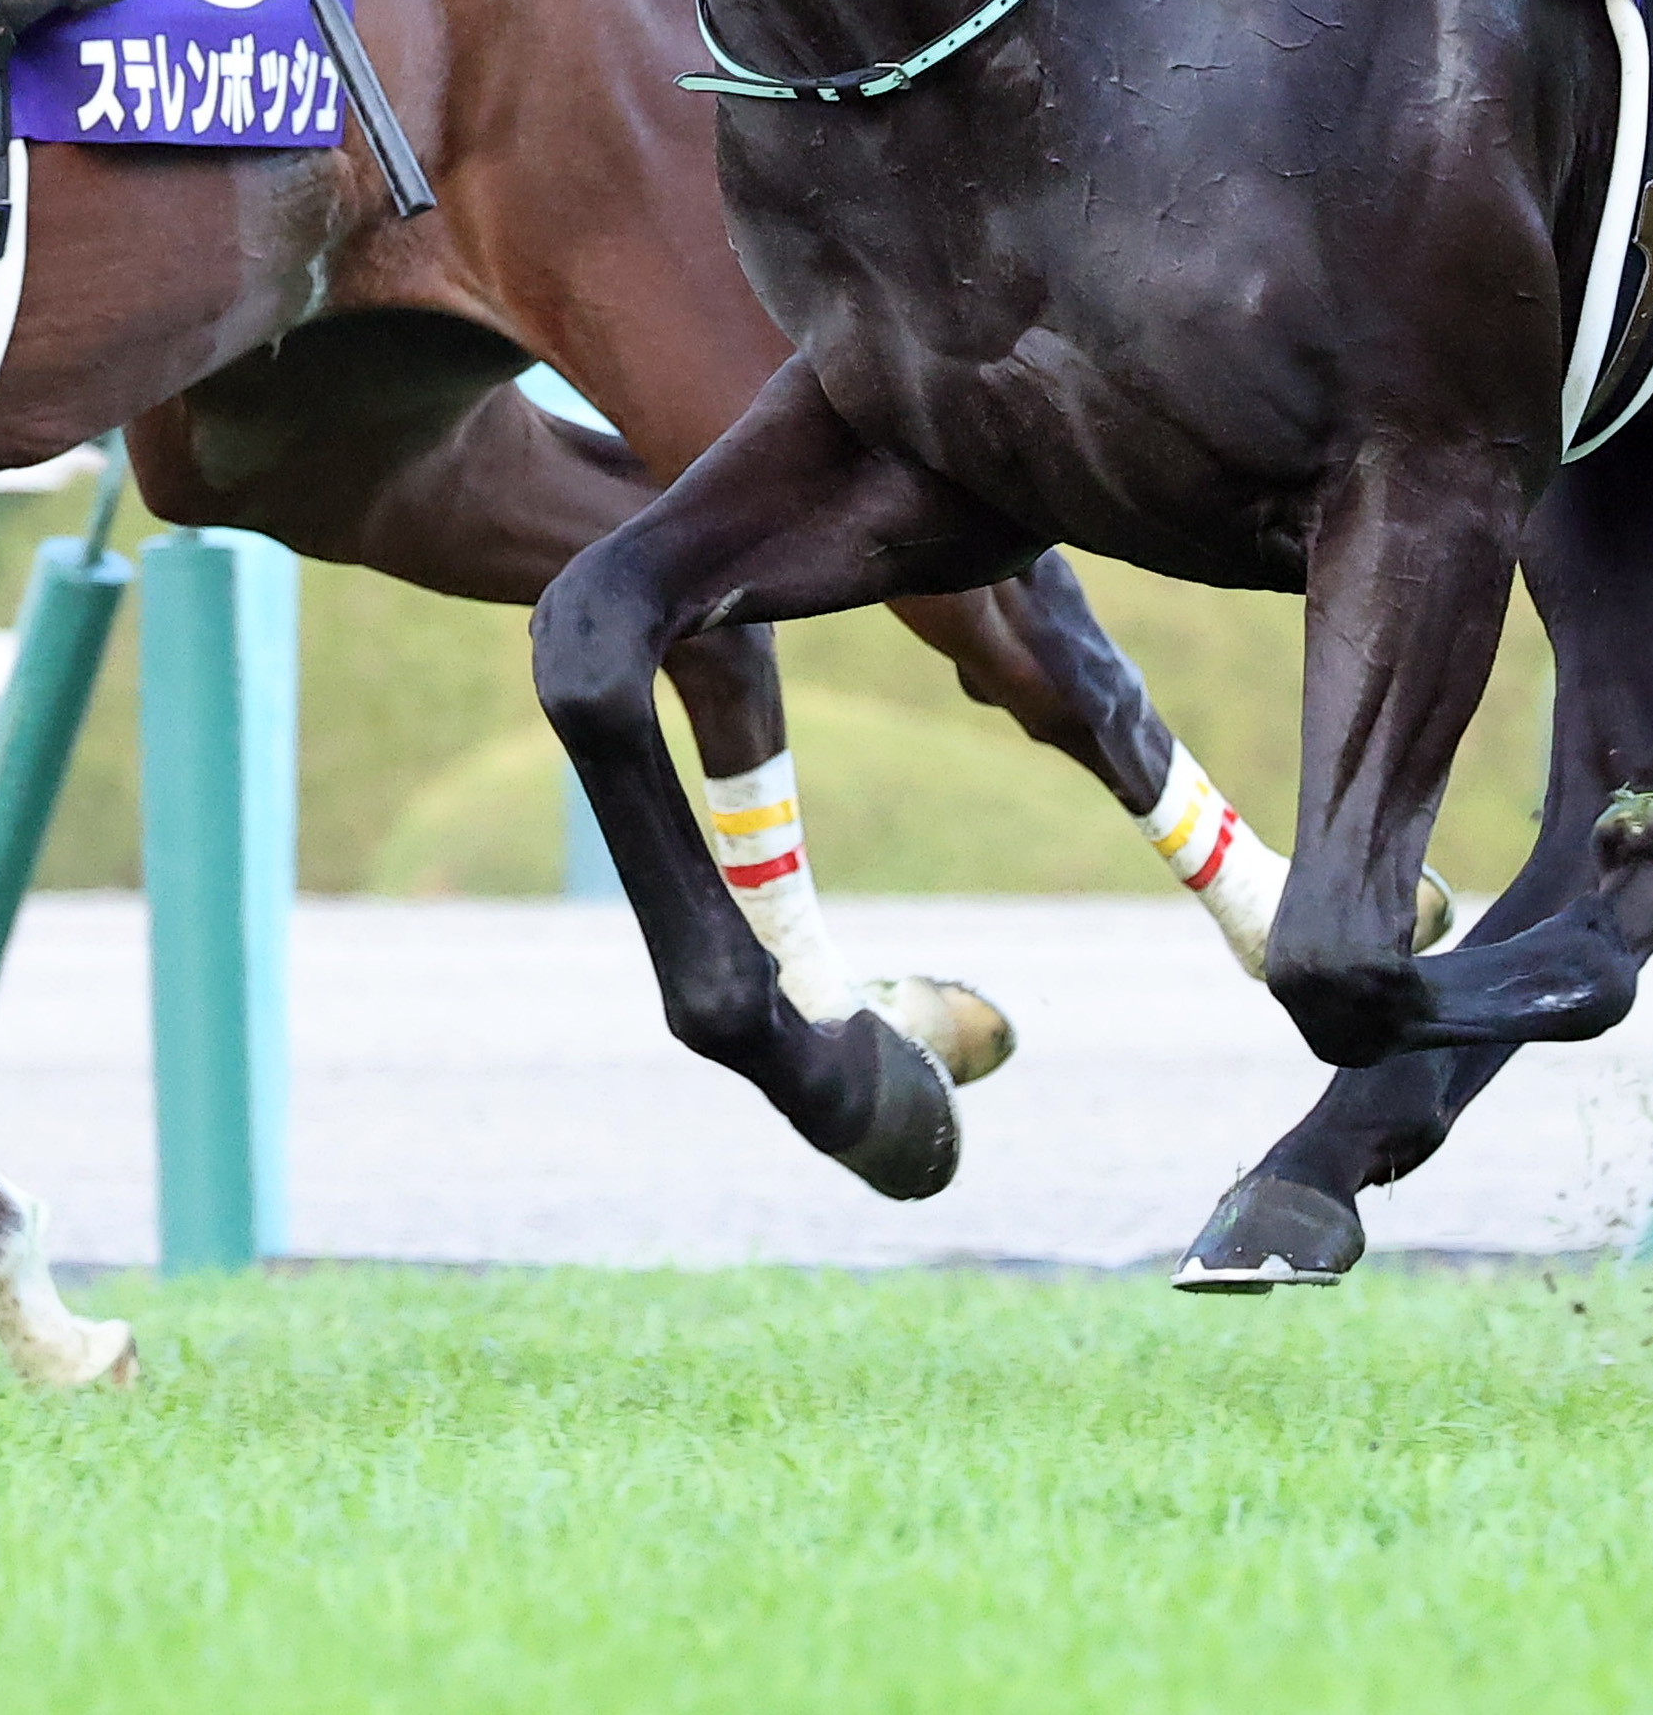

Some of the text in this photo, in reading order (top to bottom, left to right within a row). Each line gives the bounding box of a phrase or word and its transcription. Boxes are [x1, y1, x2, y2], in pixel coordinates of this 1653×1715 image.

[76, 34, 339, 135] ステレンボッシュ
